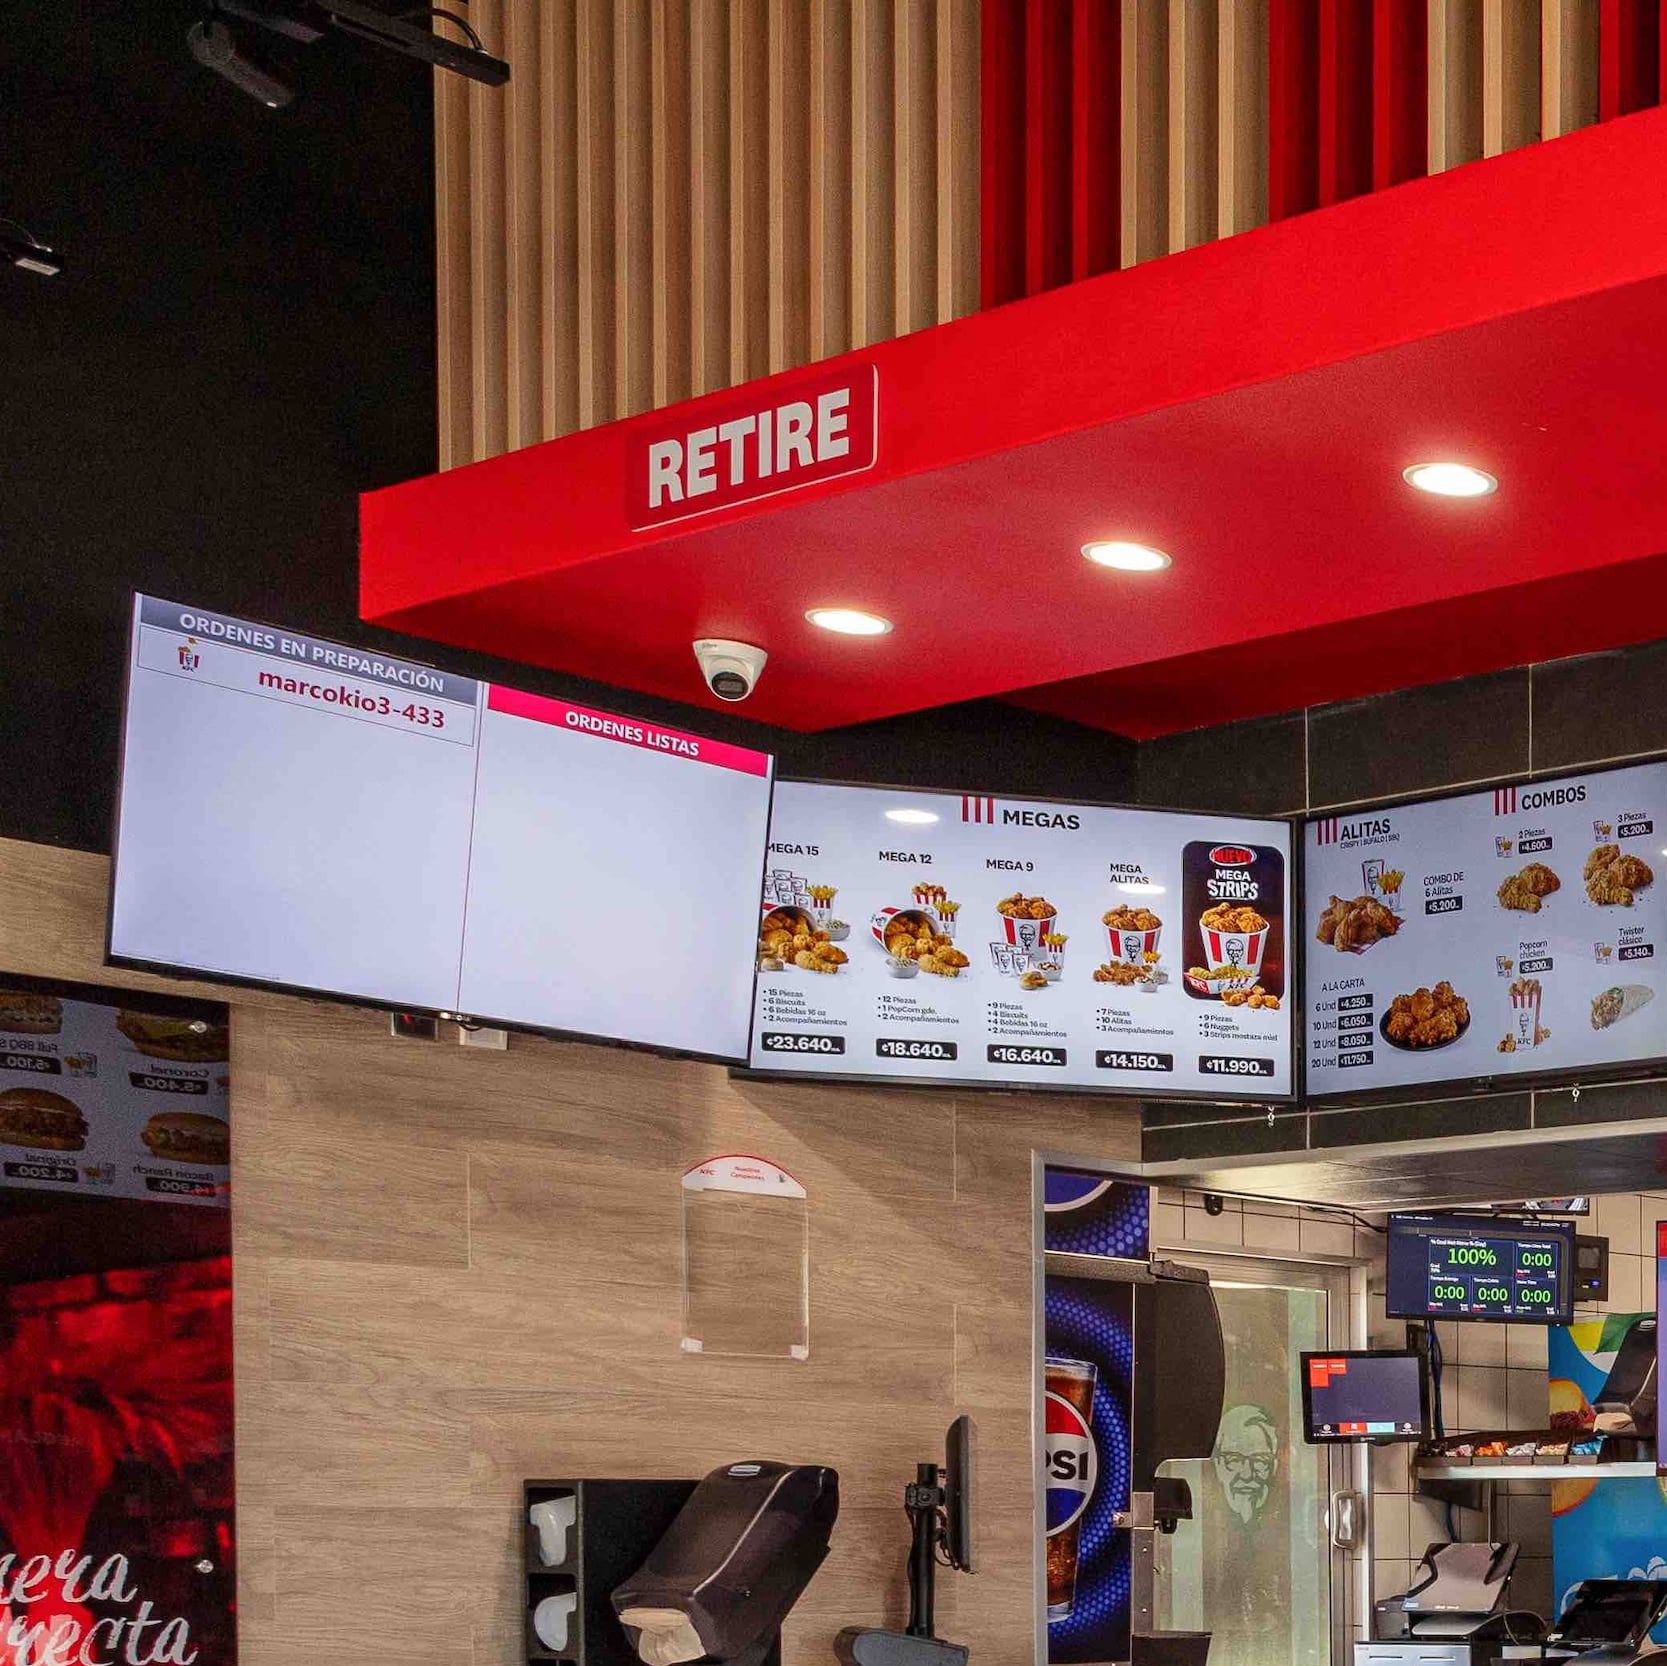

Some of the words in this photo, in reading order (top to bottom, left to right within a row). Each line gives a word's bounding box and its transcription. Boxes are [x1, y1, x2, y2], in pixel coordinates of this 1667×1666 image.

[649, 387, 850, 508] RETIRE
[180, 612, 275, 653] ORDENES
[280, 638, 307, 658] EN
[312, 645, 444, 693] PREPARACIÓN
[257, 667, 446, 730] marcokio3-433
[564, 710, 643, 742] ORDENES
[647, 728, 700, 757] LISTAS
[1521, 785, 1586, 810] COMBOS
[1003, 810, 1080, 829] MEGAS
[1341, 818, 1391, 842] ALITAS
[806, 845, 819, 856] 15
[879, 851, 917, 863] MEGA
[920, 853, 932, 864] 12
[986, 859, 1024, 871] MEGA
[1026, 861, 1034, 872] 9
[1110, 863, 1142, 874] MEGA
[1110, 874, 1149, 885] ALITAS
[1215, 869, 1251, 881] MEGA
[1207, 880, 1259, 901] STRIPS
[1448, 1248, 1496, 1266] 100%
[1522, 1253, 1552, 1266] 0:00
[1435, 1286, 1465, 1299] 0:00
[1478, 1287, 1508, 1300] 0:00
[1521, 1289, 1551, 1302] 0:00
[1045, 1449, 1089, 1480] SI
